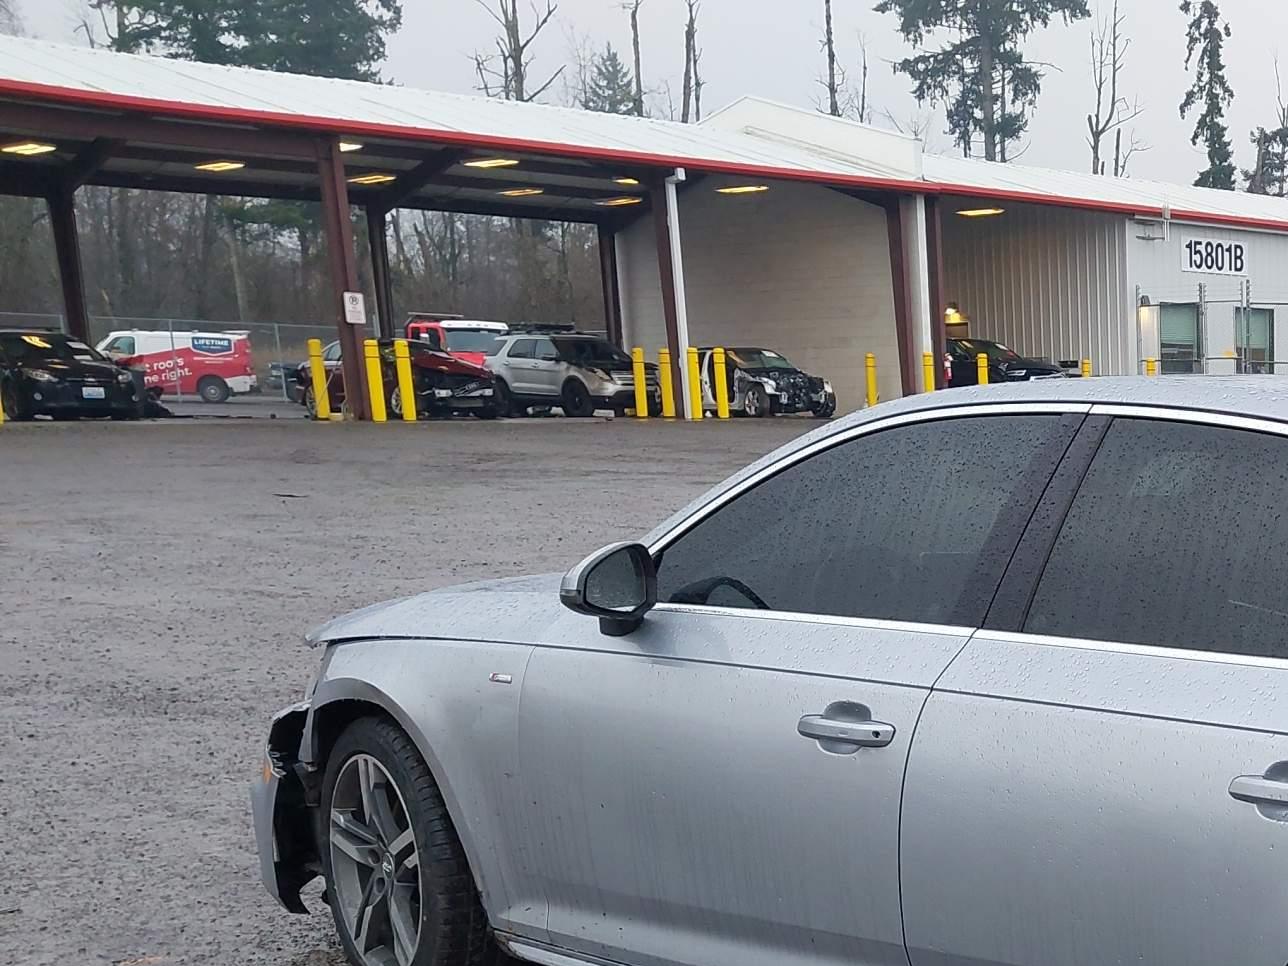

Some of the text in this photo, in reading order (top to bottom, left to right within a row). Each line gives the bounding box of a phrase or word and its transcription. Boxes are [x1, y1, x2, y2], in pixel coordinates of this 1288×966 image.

[1185, 239, 1244, 272] 15801B
[153, 356, 185, 372] roos
[161, 367, 193, 381] right.
